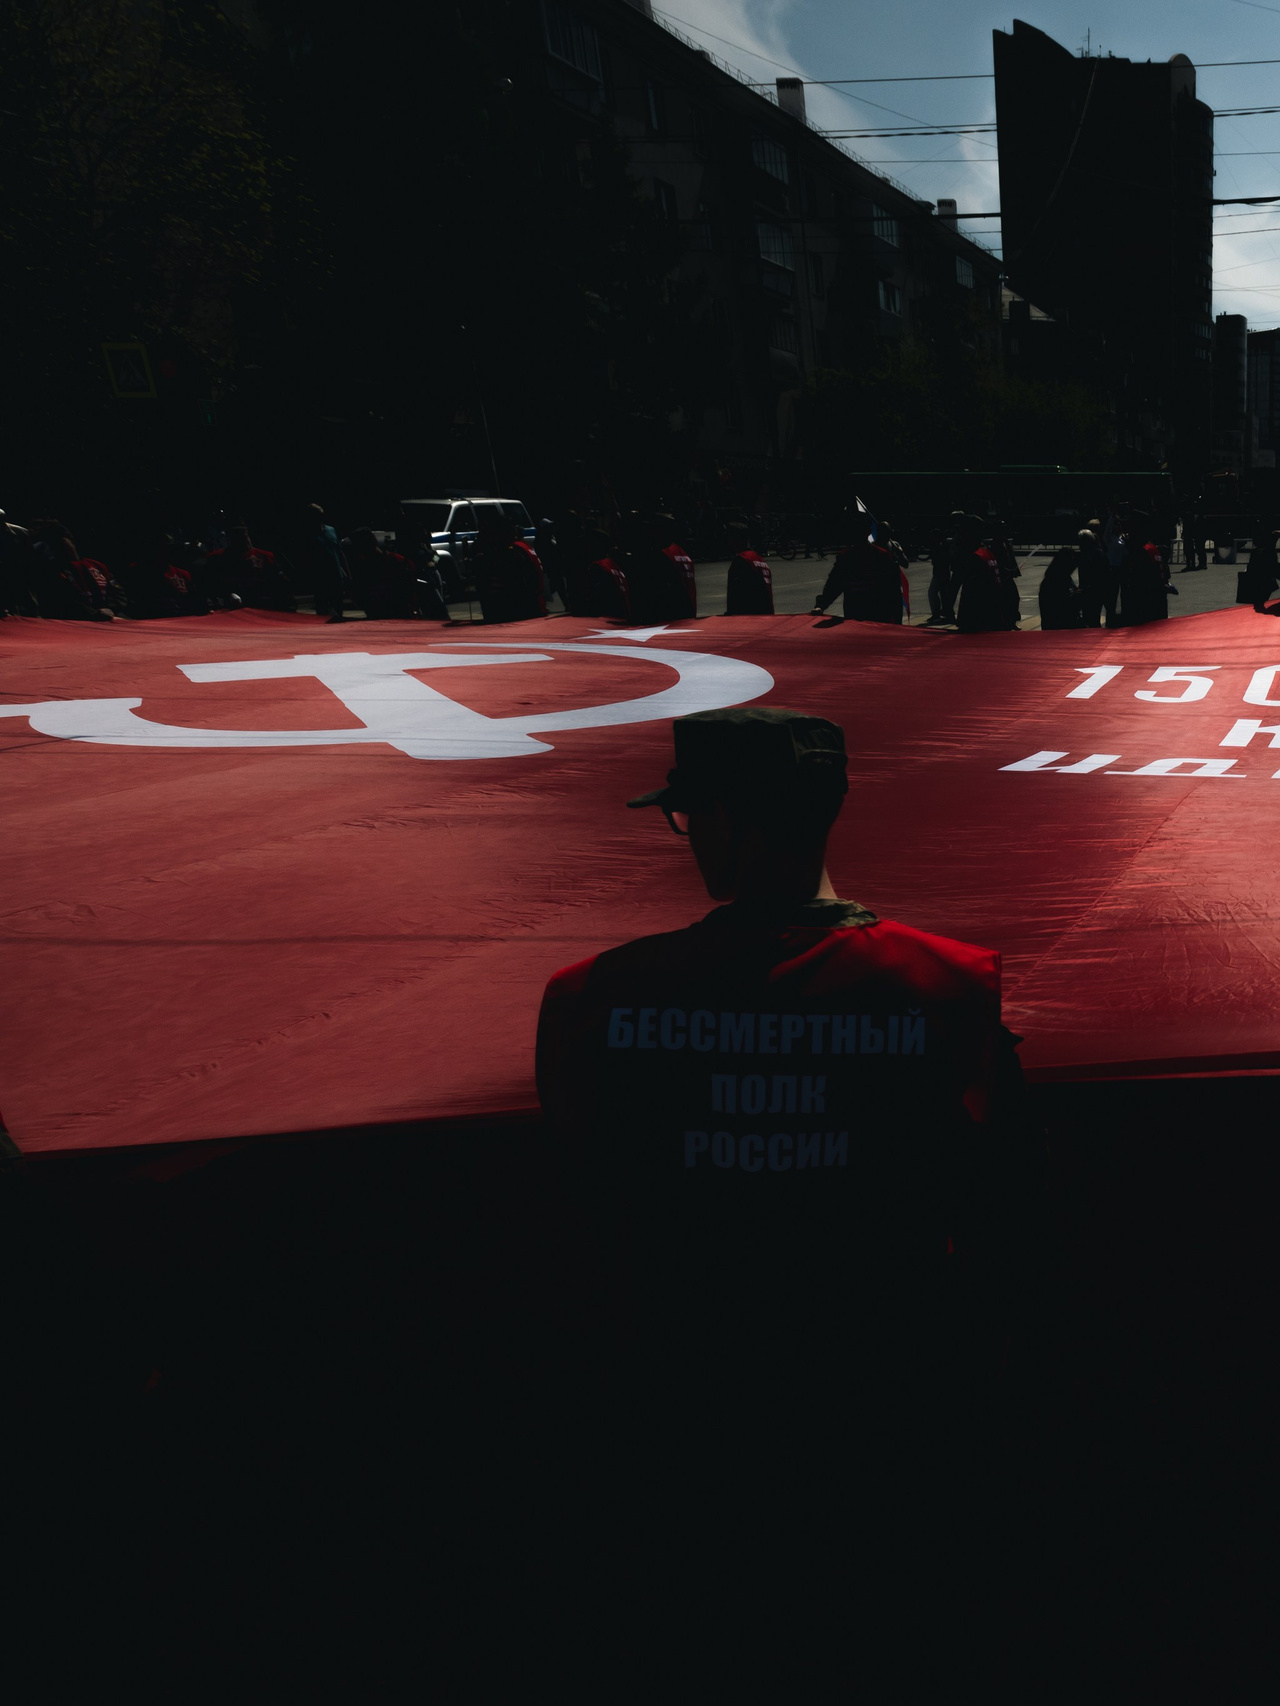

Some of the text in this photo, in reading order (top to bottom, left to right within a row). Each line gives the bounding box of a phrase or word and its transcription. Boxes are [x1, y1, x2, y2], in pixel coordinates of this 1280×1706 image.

[607, 1007, 927, 1056] БЕССМЕРТНЫЙ
[711, 1073, 827, 1115] ПОЛК
[683, 1130, 849, 1173] РОССИИ
